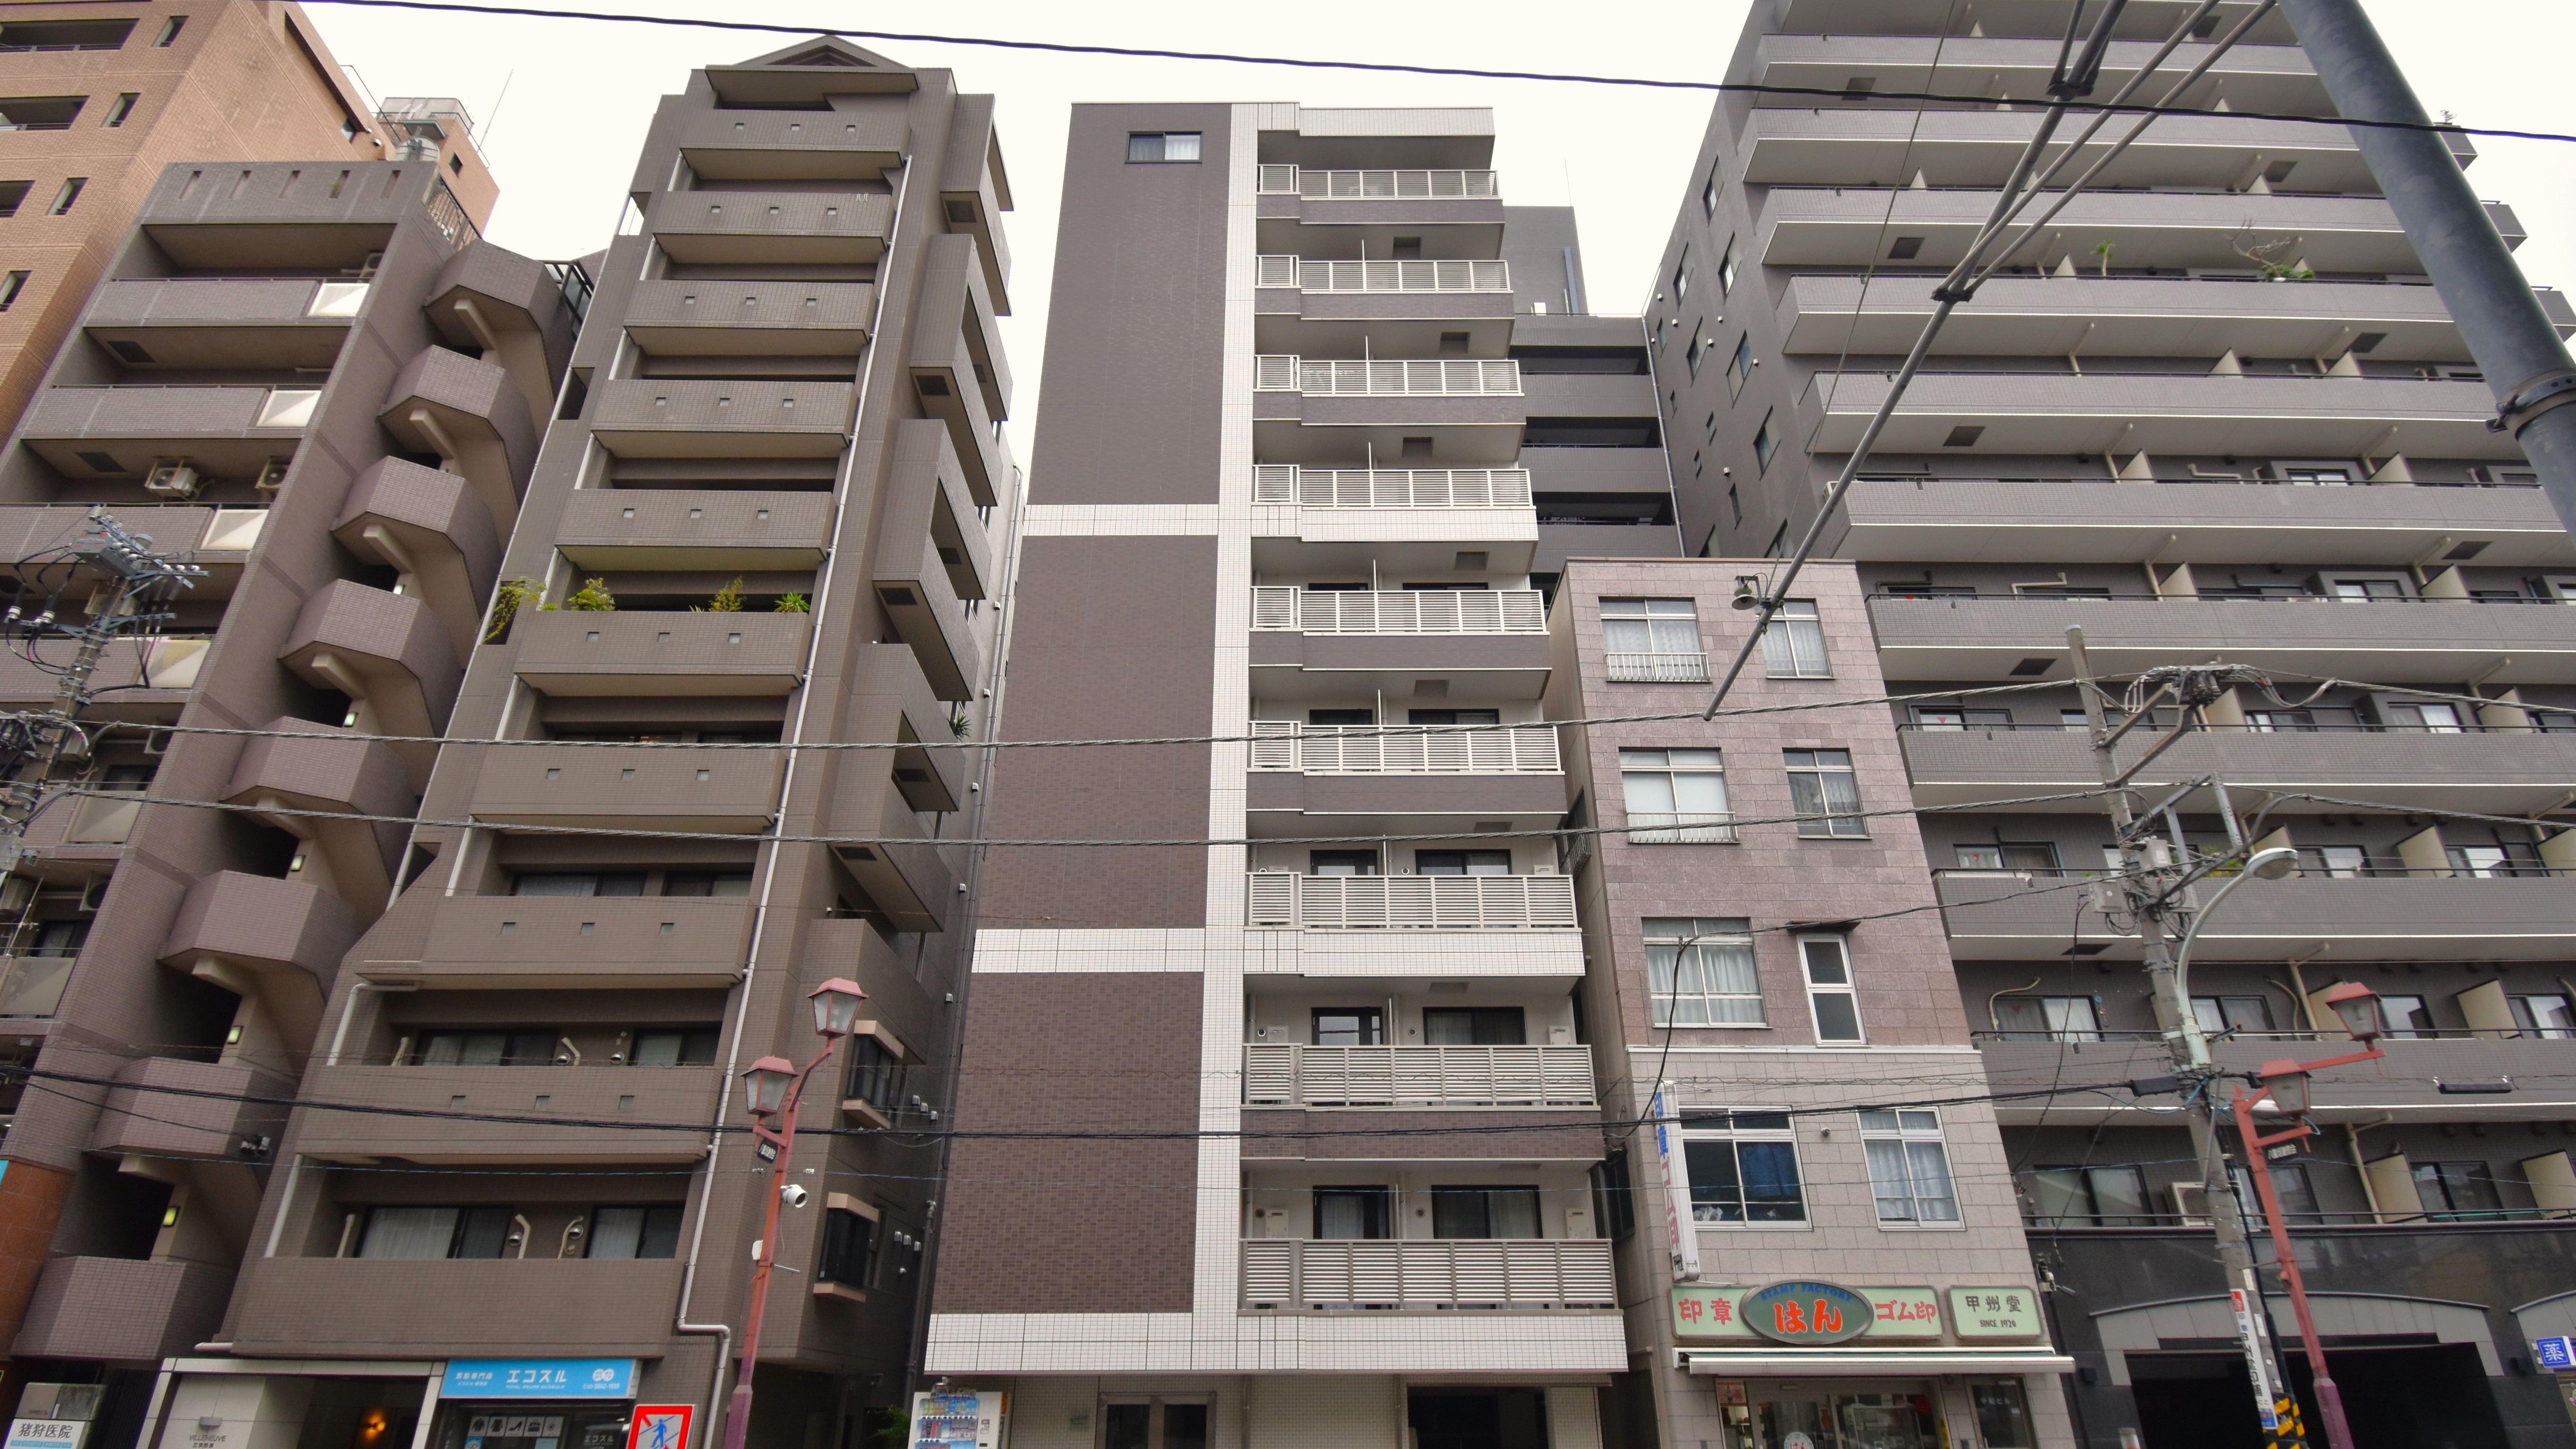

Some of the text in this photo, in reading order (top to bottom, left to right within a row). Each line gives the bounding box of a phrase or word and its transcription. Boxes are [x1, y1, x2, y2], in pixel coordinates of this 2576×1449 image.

[1760, 1283, 1854, 1302] STAMP FACTORY
[1678, 1298, 1733, 1325] 印章
[1875, 1299, 1937, 1324] ゴム印
[1965, 1295, 2022, 1313] 甲州堂
[1773, 1299, 1843, 1334] はん
[1980, 1320, 2017, 1328] SINCE 1920
[2543, 1343, 2564, 1361] 薬
[506, 1370, 567, 1383] エコスル
[18, 1423, 73, 1439] 猪狩医院
[189, 1434, 227, 1442] VILLENEUVE
